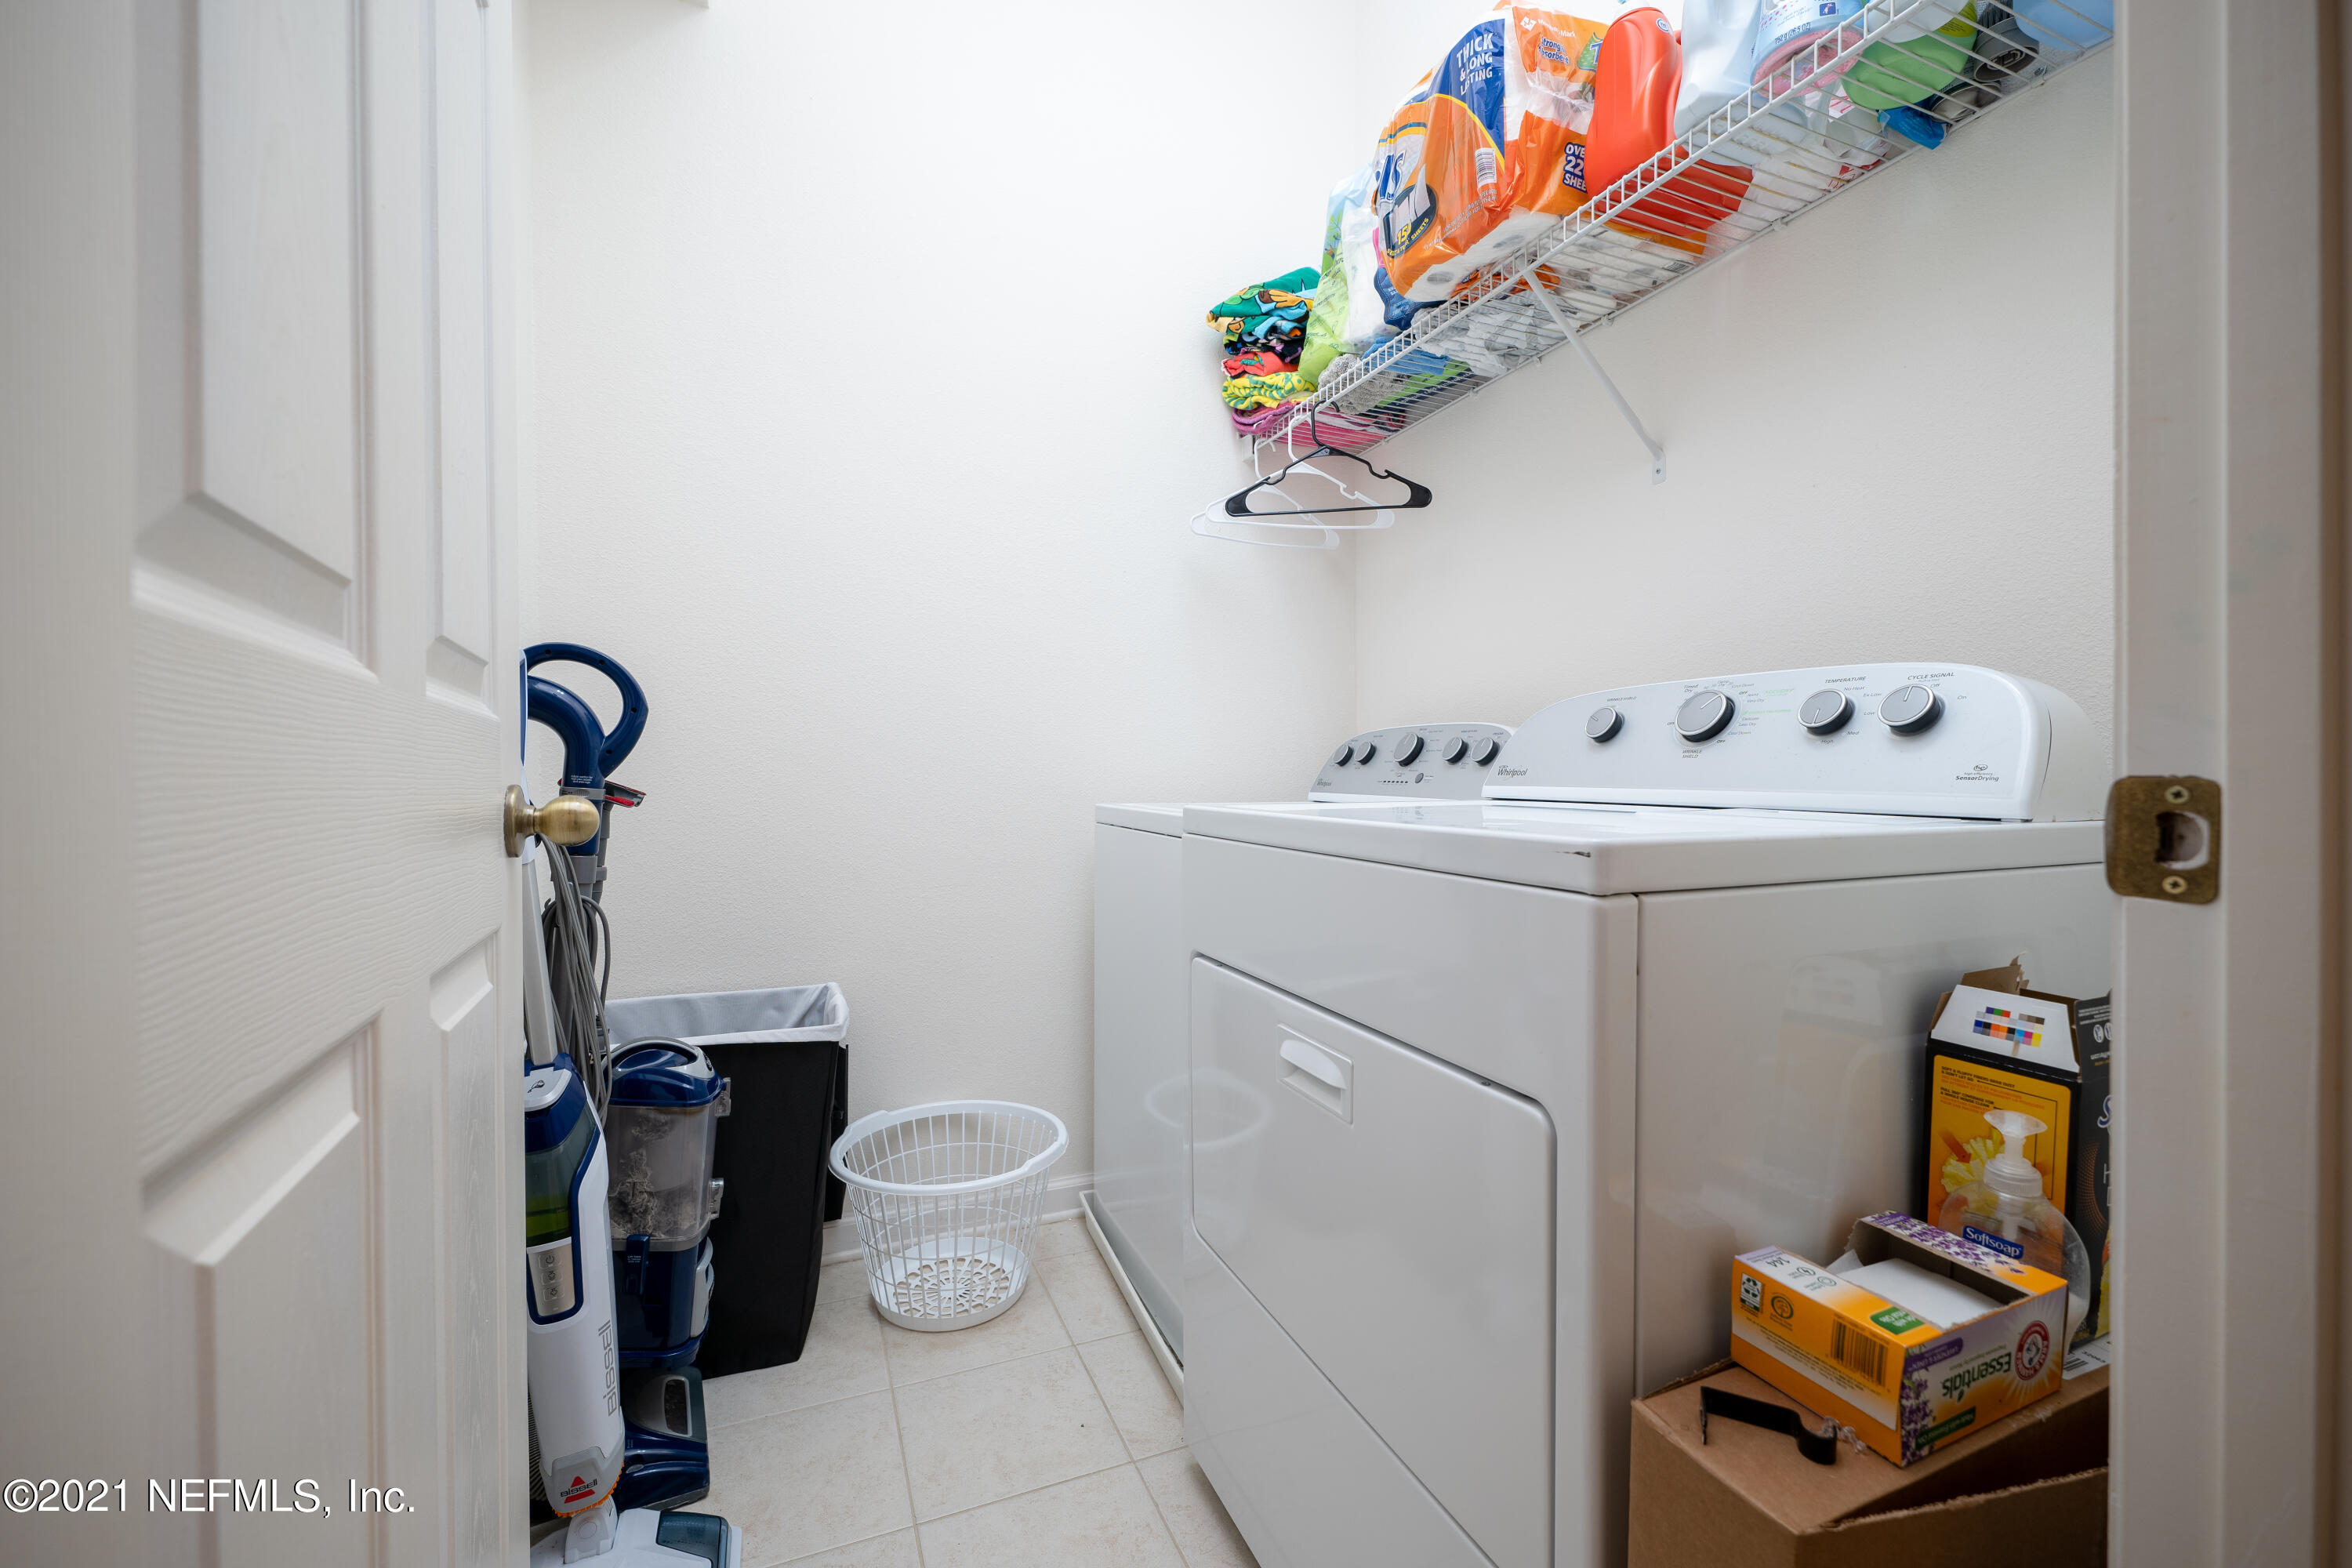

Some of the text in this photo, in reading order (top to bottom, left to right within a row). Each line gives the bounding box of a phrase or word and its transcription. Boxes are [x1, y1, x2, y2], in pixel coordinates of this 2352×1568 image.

[1457, 33, 1494, 68] THICK
[1460, 52, 1493, 82] & LONG
[1460, 67, 1493, 96] LASTING
[1566, 143, 1585, 158] OVE
[1565, 155, 1584, 176] 22
[1563, 173, 1587, 191] SHEE
[1498, 768, 1529, 778] Whirlpool
[1966, 1227, 2020, 1258] Softsoap
[1940, 1352, 2012, 1401] Essentials
